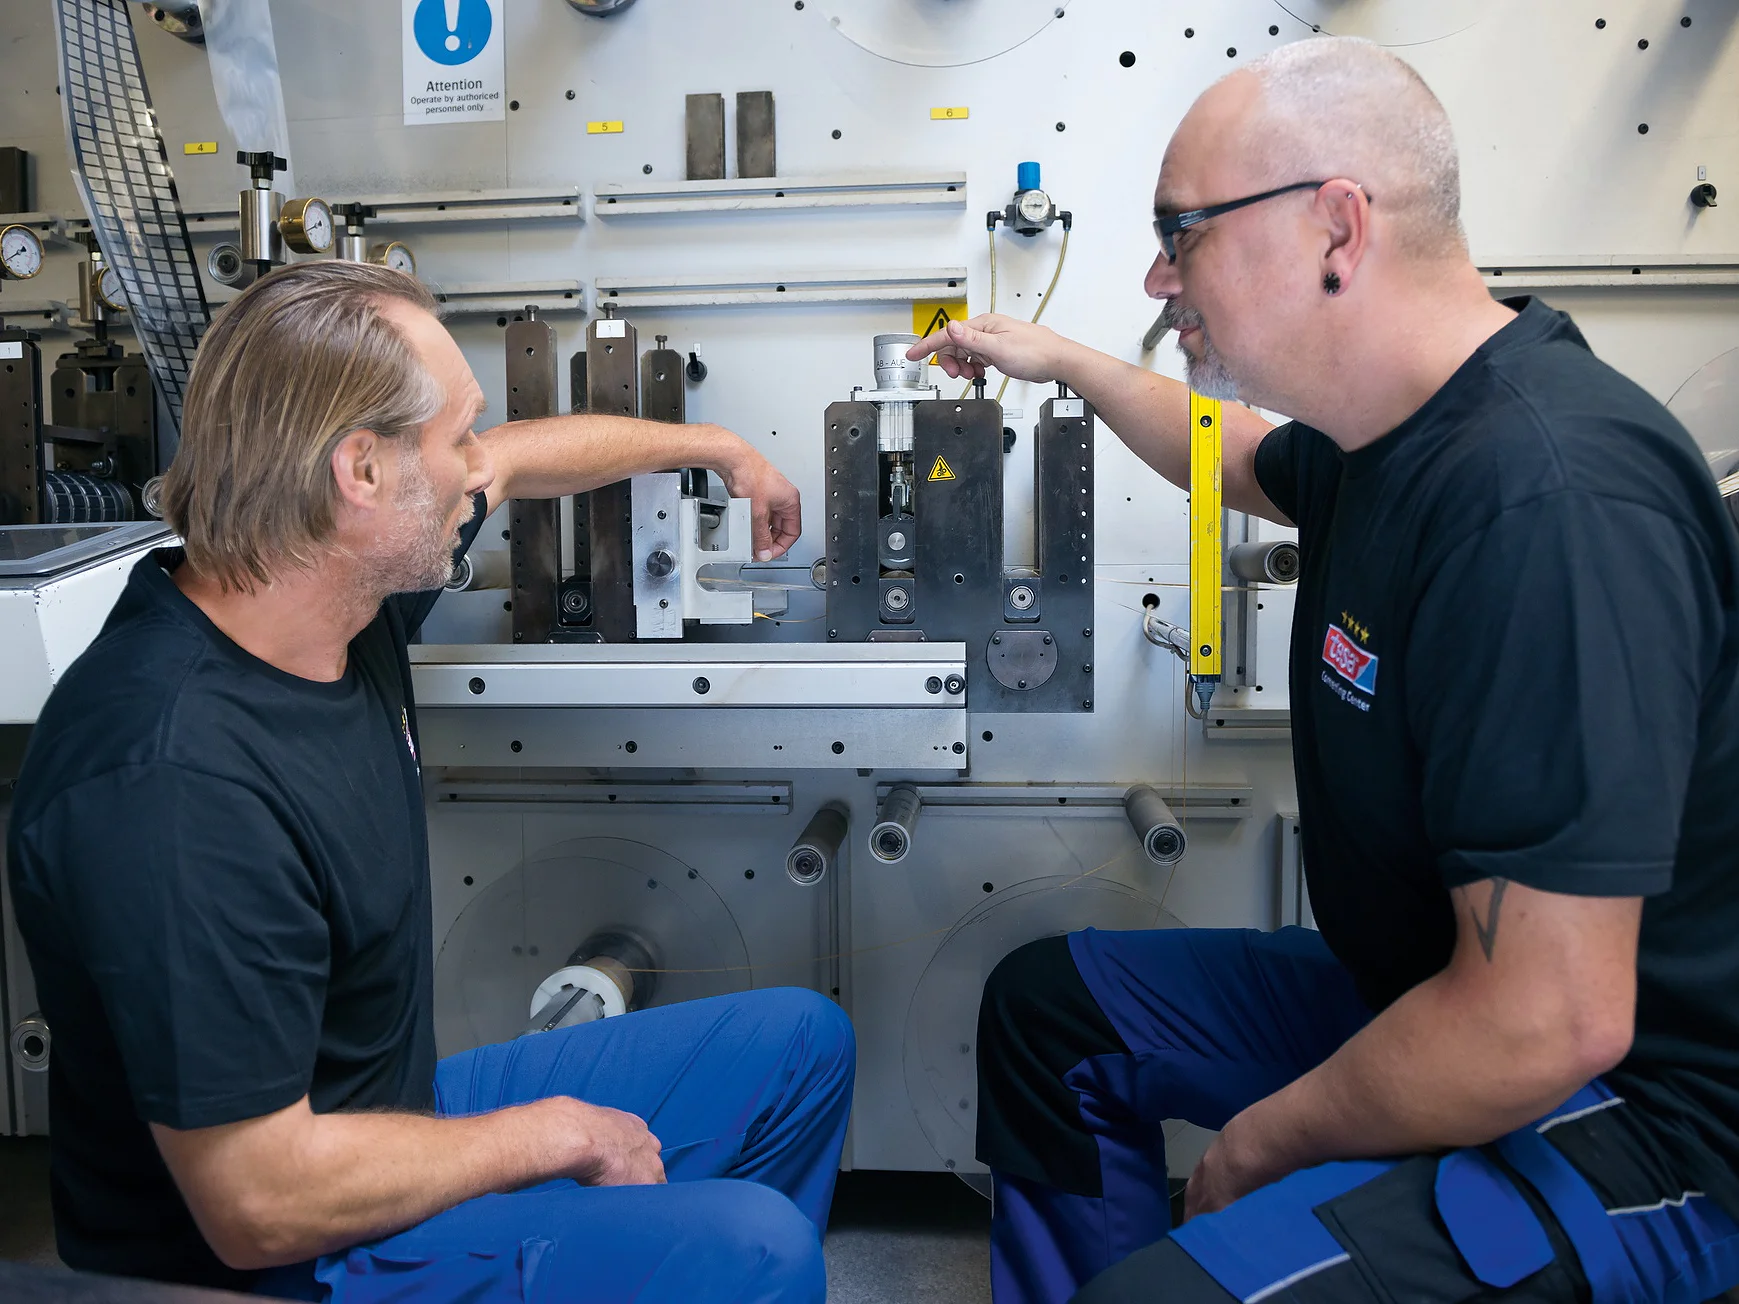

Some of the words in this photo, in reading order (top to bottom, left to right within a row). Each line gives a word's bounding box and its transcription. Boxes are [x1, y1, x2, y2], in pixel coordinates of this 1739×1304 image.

[426, 79, 483, 92] Attention
[410, 96, 442, 105] Operate
[444, 95, 454, 103] by
[457, 92, 499, 102] authoriced
[425, 105, 465, 115] personnel
[467, 103, 484, 112] only
[946, 108, 953, 117] 6
[602, 122, 608, 131] 5
[1328, 634, 1360, 675] tesa
[1346, 691, 1371, 713] Center
